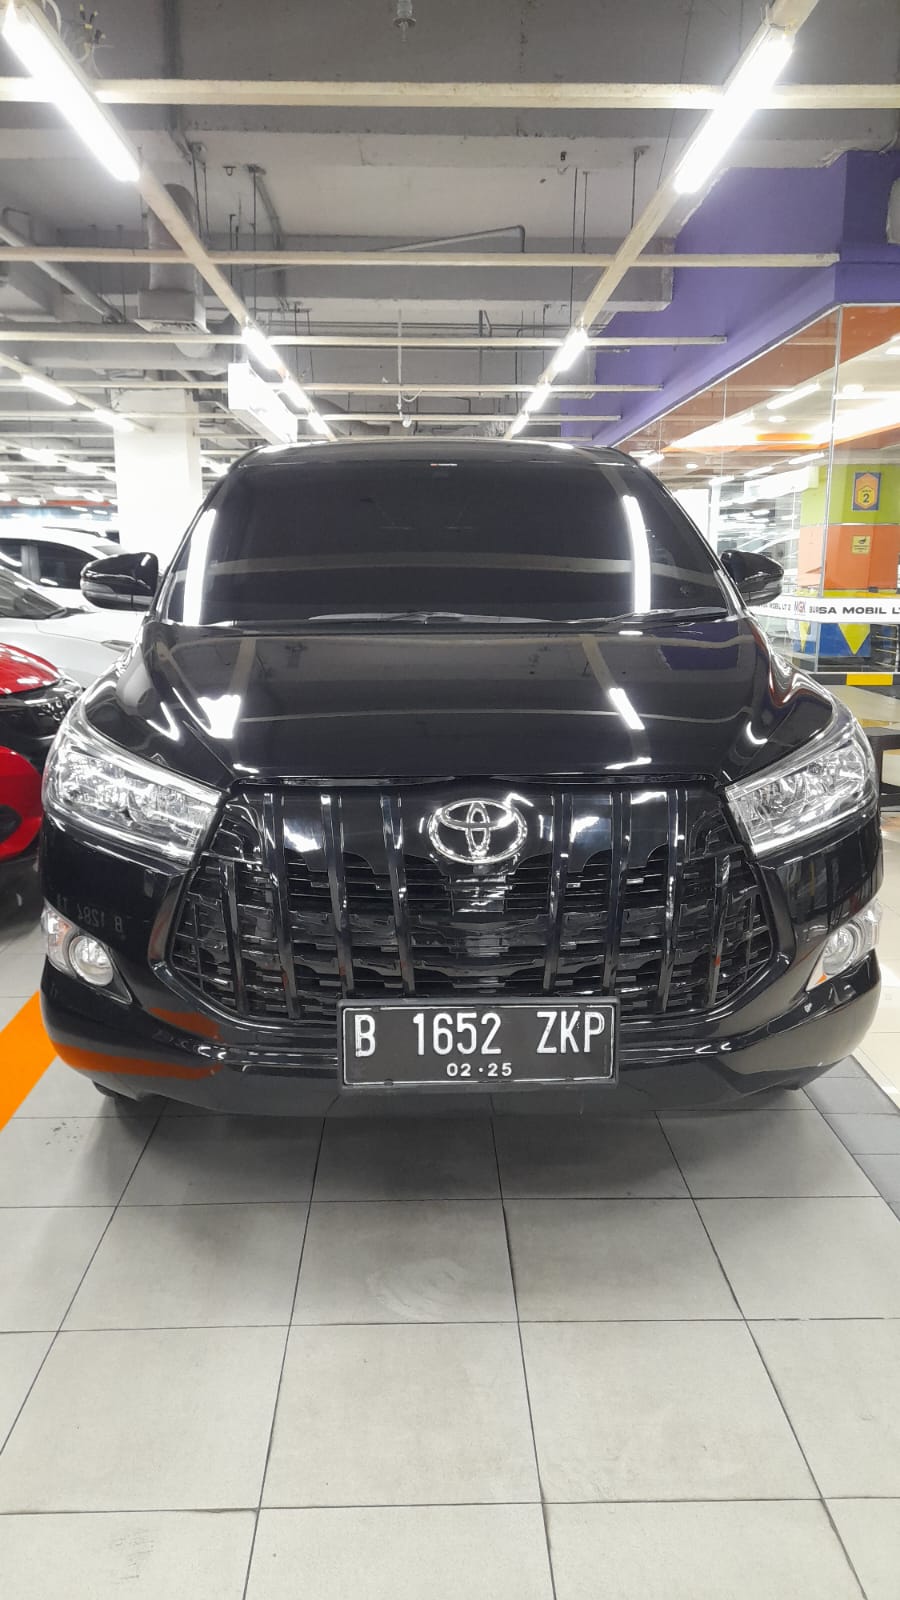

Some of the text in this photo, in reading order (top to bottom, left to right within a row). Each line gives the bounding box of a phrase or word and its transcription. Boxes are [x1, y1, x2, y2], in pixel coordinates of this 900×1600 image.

[863, 493, 870, 503] 2
[842, 606, 887, 615] MOBIL
[354, 1010, 606, 1057] B 1652 ZKP
